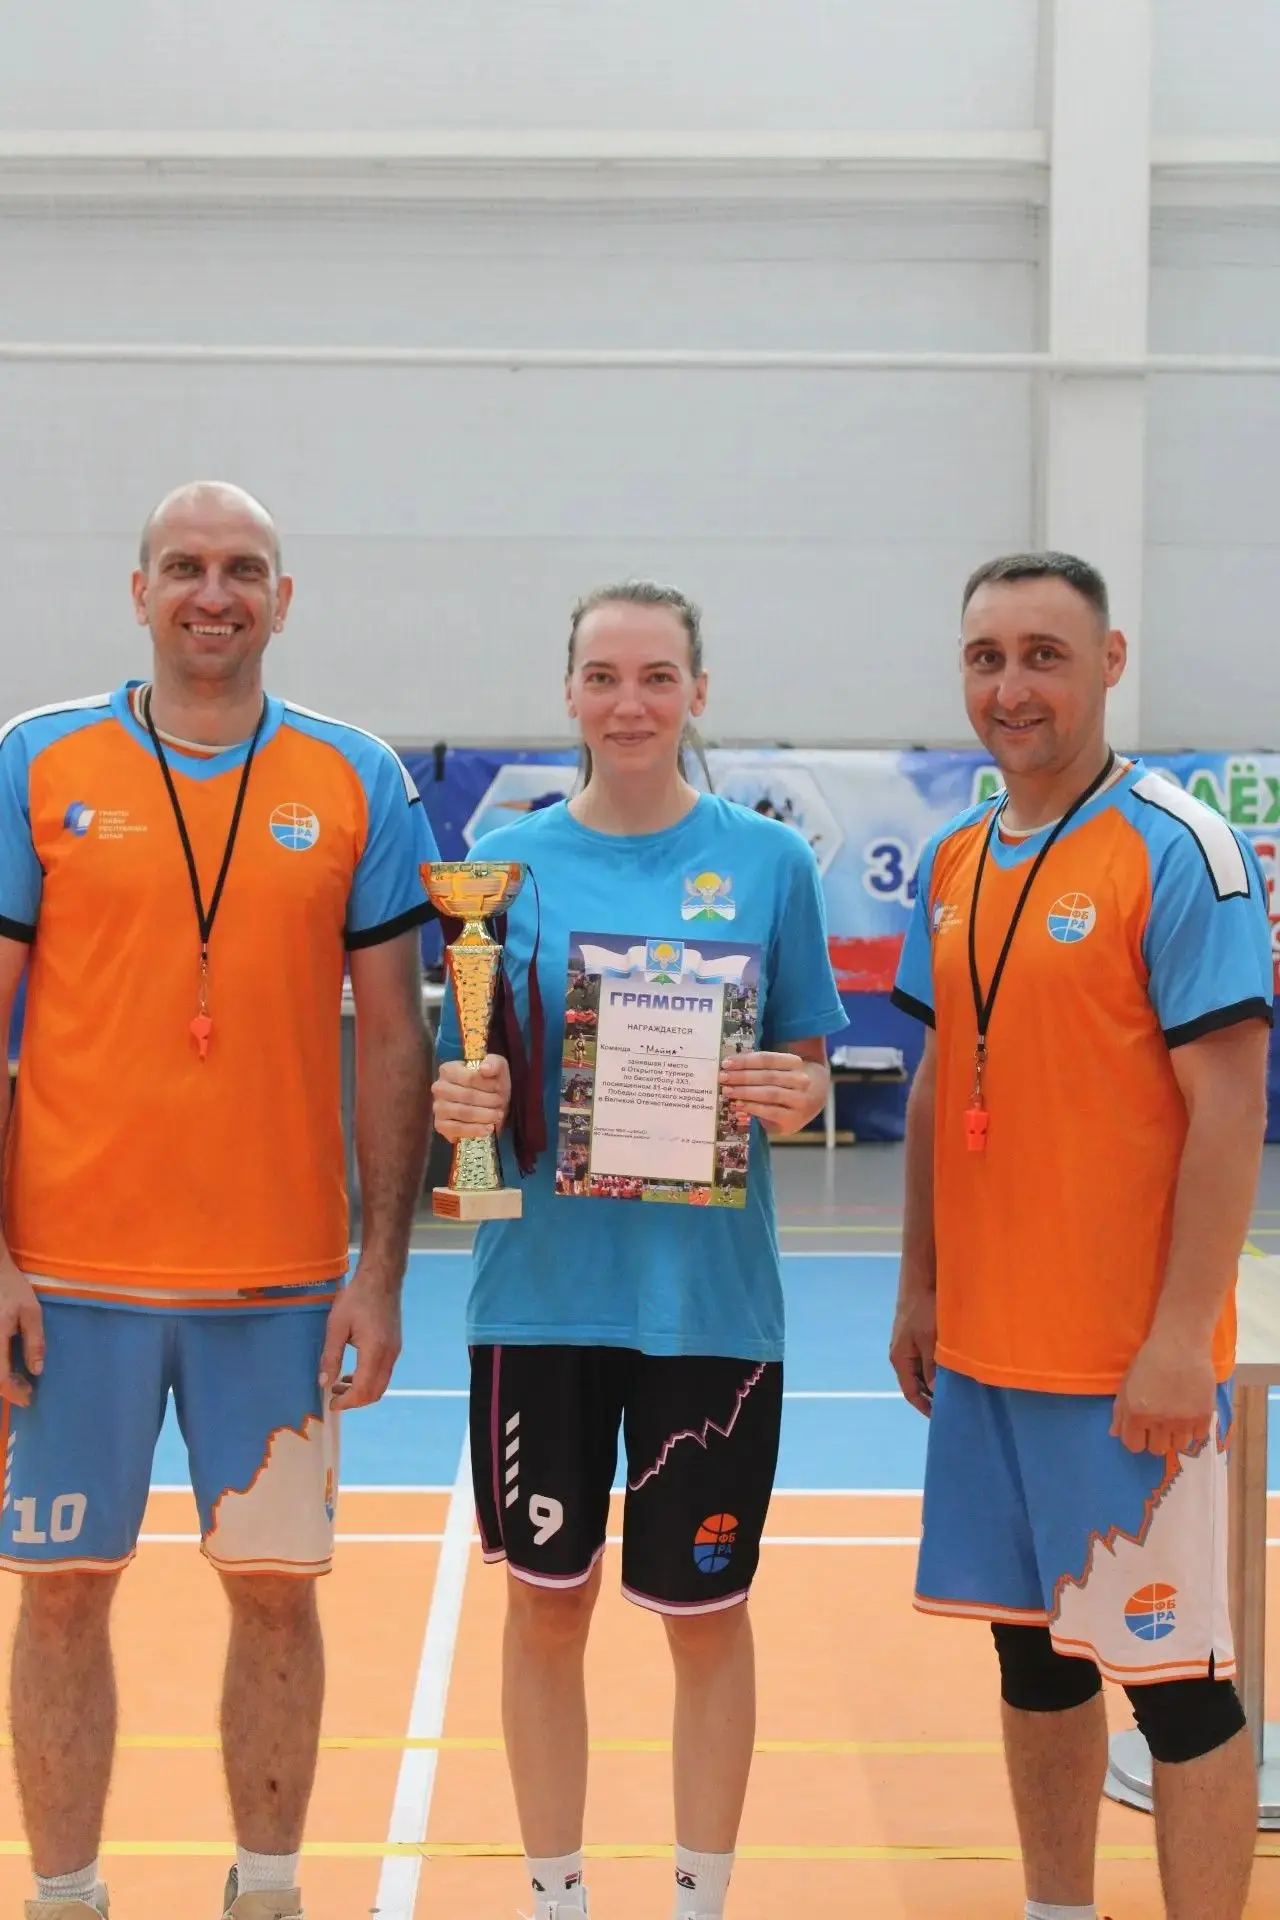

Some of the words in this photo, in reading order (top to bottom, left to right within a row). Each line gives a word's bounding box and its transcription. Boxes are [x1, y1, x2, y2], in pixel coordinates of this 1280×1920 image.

[295, 819, 313, 828] ФБ
[296, 827, 313, 837] РА
[1071, 910, 1089, 920] ФБ
[1070, 919, 1087, 930] РА
[610, 991, 713, 1013] ГРАМОТА
[627, 1023, 693, 1035] НАГРАЖДАЕТСЯ
[600, 1043, 631, 1053] Команда
[628, 1059, 662, 1068] занявшая
[627, 1066, 663, 1076] Открытом
[633, 1074, 674, 1085] баскетболу
[607, 1088, 636, 1097] Победы
[638, 1092, 677, 1101] советского
[679, 1095, 705, 1103] народа
[604, 1095, 635, 1105] Великой
[636, 1098, 690, 1109] Отечественной
[691, 1103, 714, 1111] войне
[12, 1492, 88, 1544] 10
[529, 1493, 563, 1546] 9
[1154, 1598, 1177, 1611] ФБ
[1156, 1610, 1176, 1622] РА
